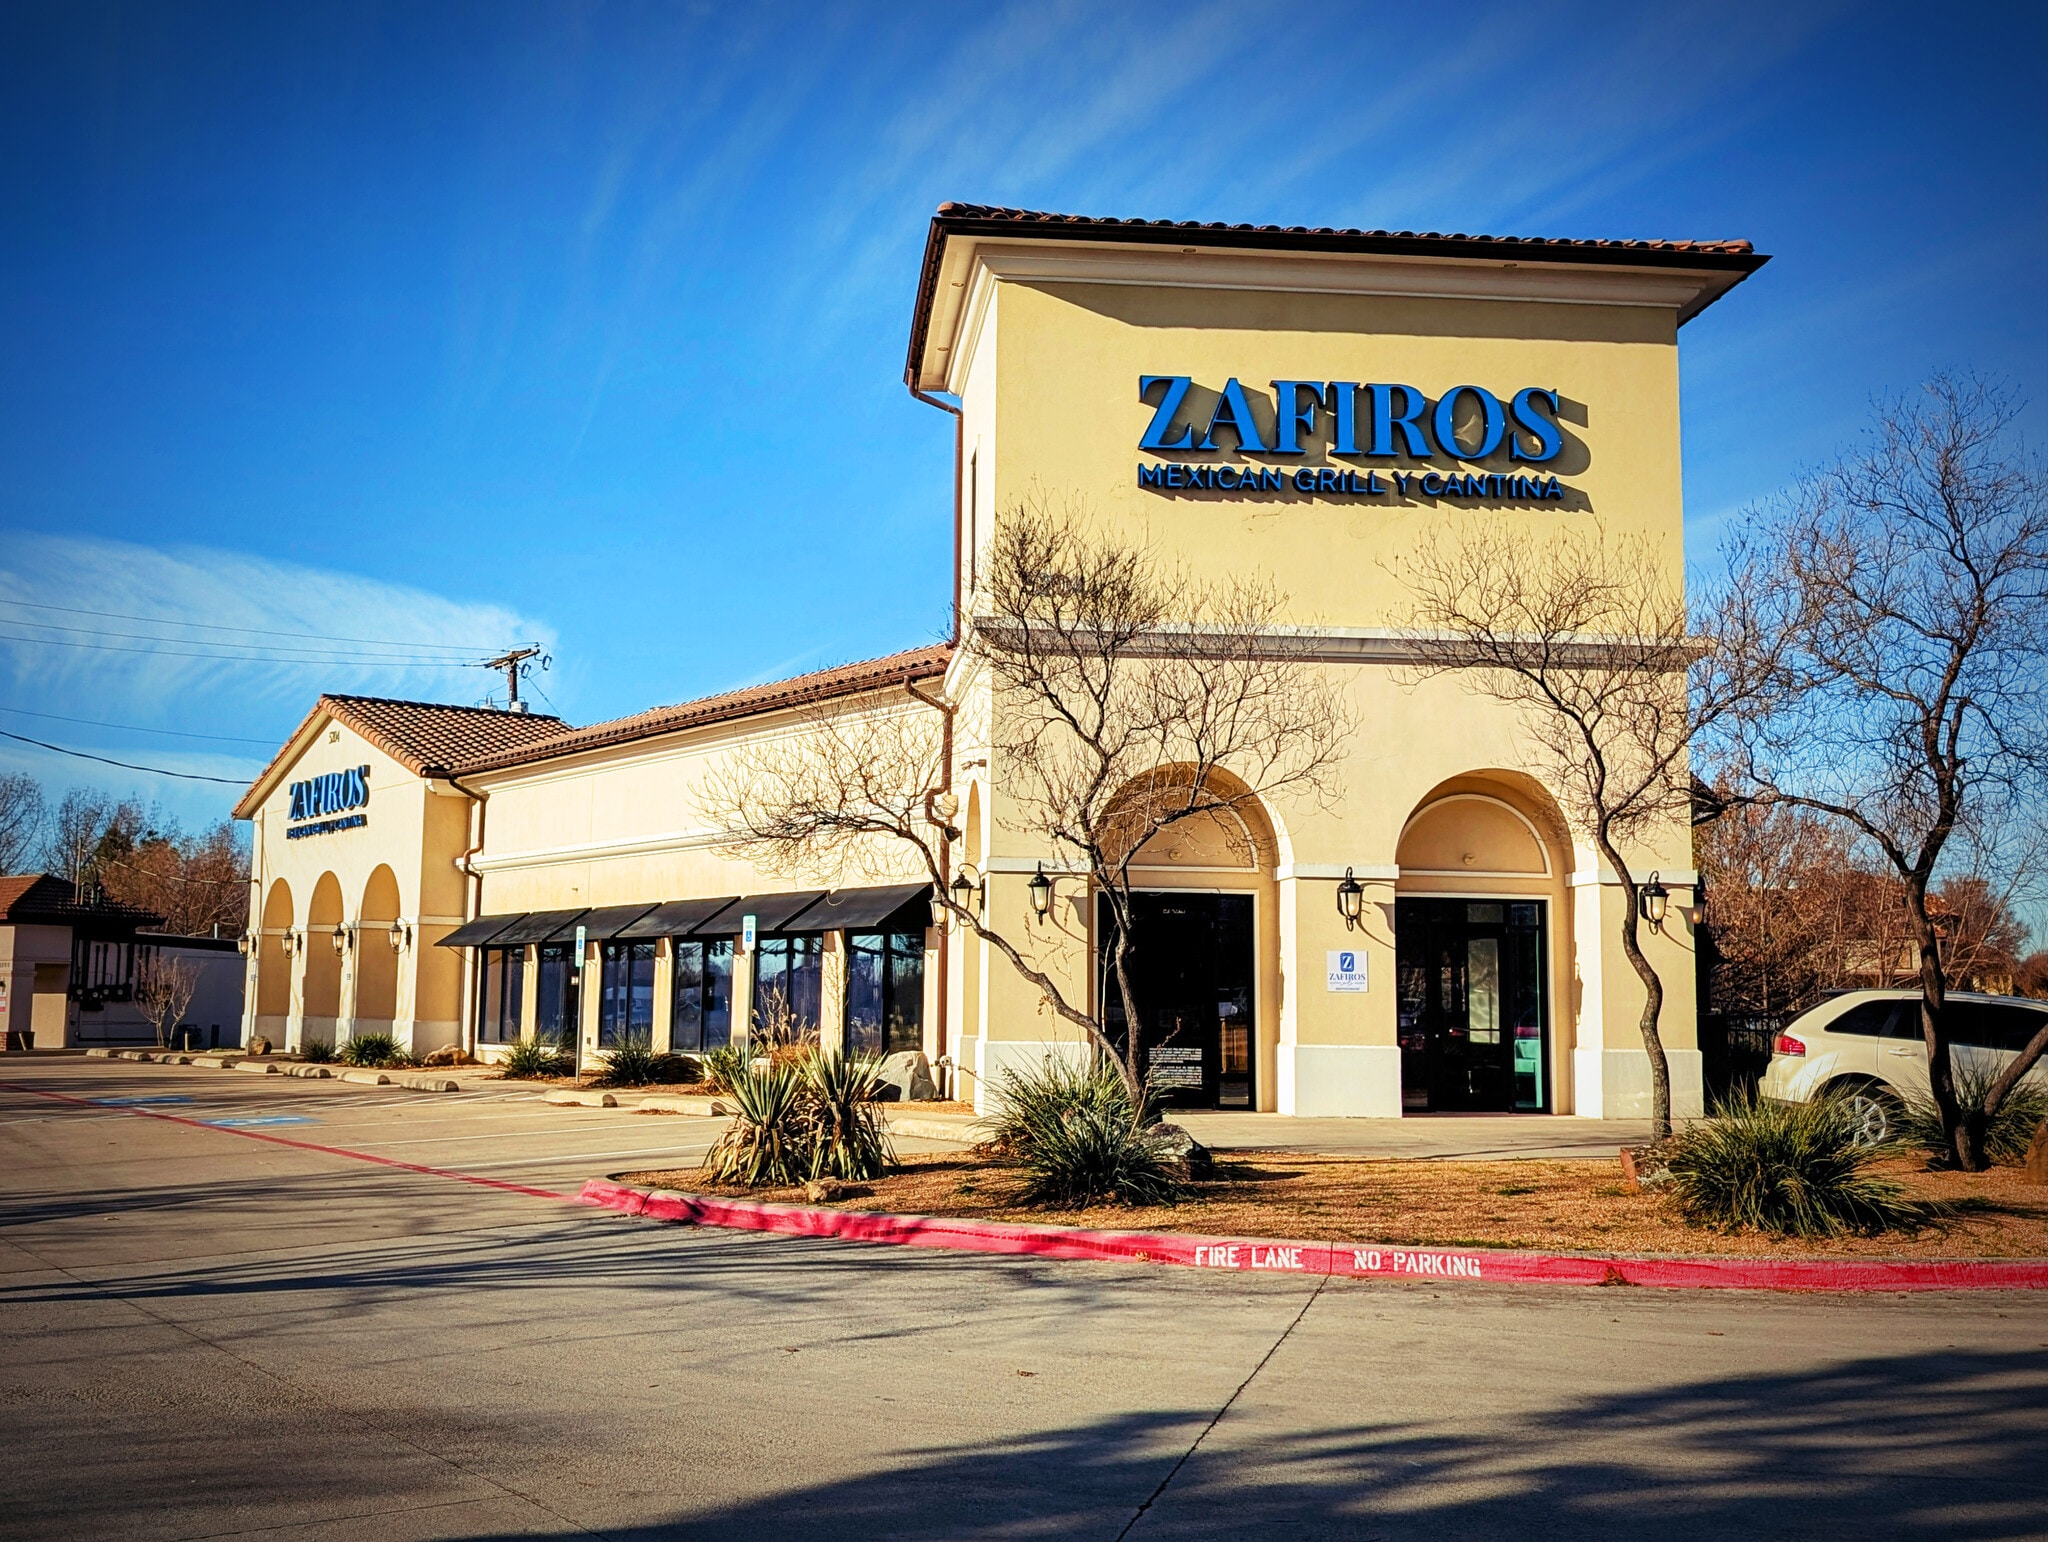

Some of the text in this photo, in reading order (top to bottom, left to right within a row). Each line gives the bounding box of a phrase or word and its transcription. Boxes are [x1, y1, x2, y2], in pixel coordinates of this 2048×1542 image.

[1139, 375, 1563, 462] ZAFIROS
[1138, 463, 1564, 500] MEXICAN GRILL Y CANTINA
[288, 765, 367, 820] ZAFIROS
[1329, 973, 1366, 981] ZAFIROS
[1195, 1246, 1481, 1277] FIRE LANE NO PARKING
